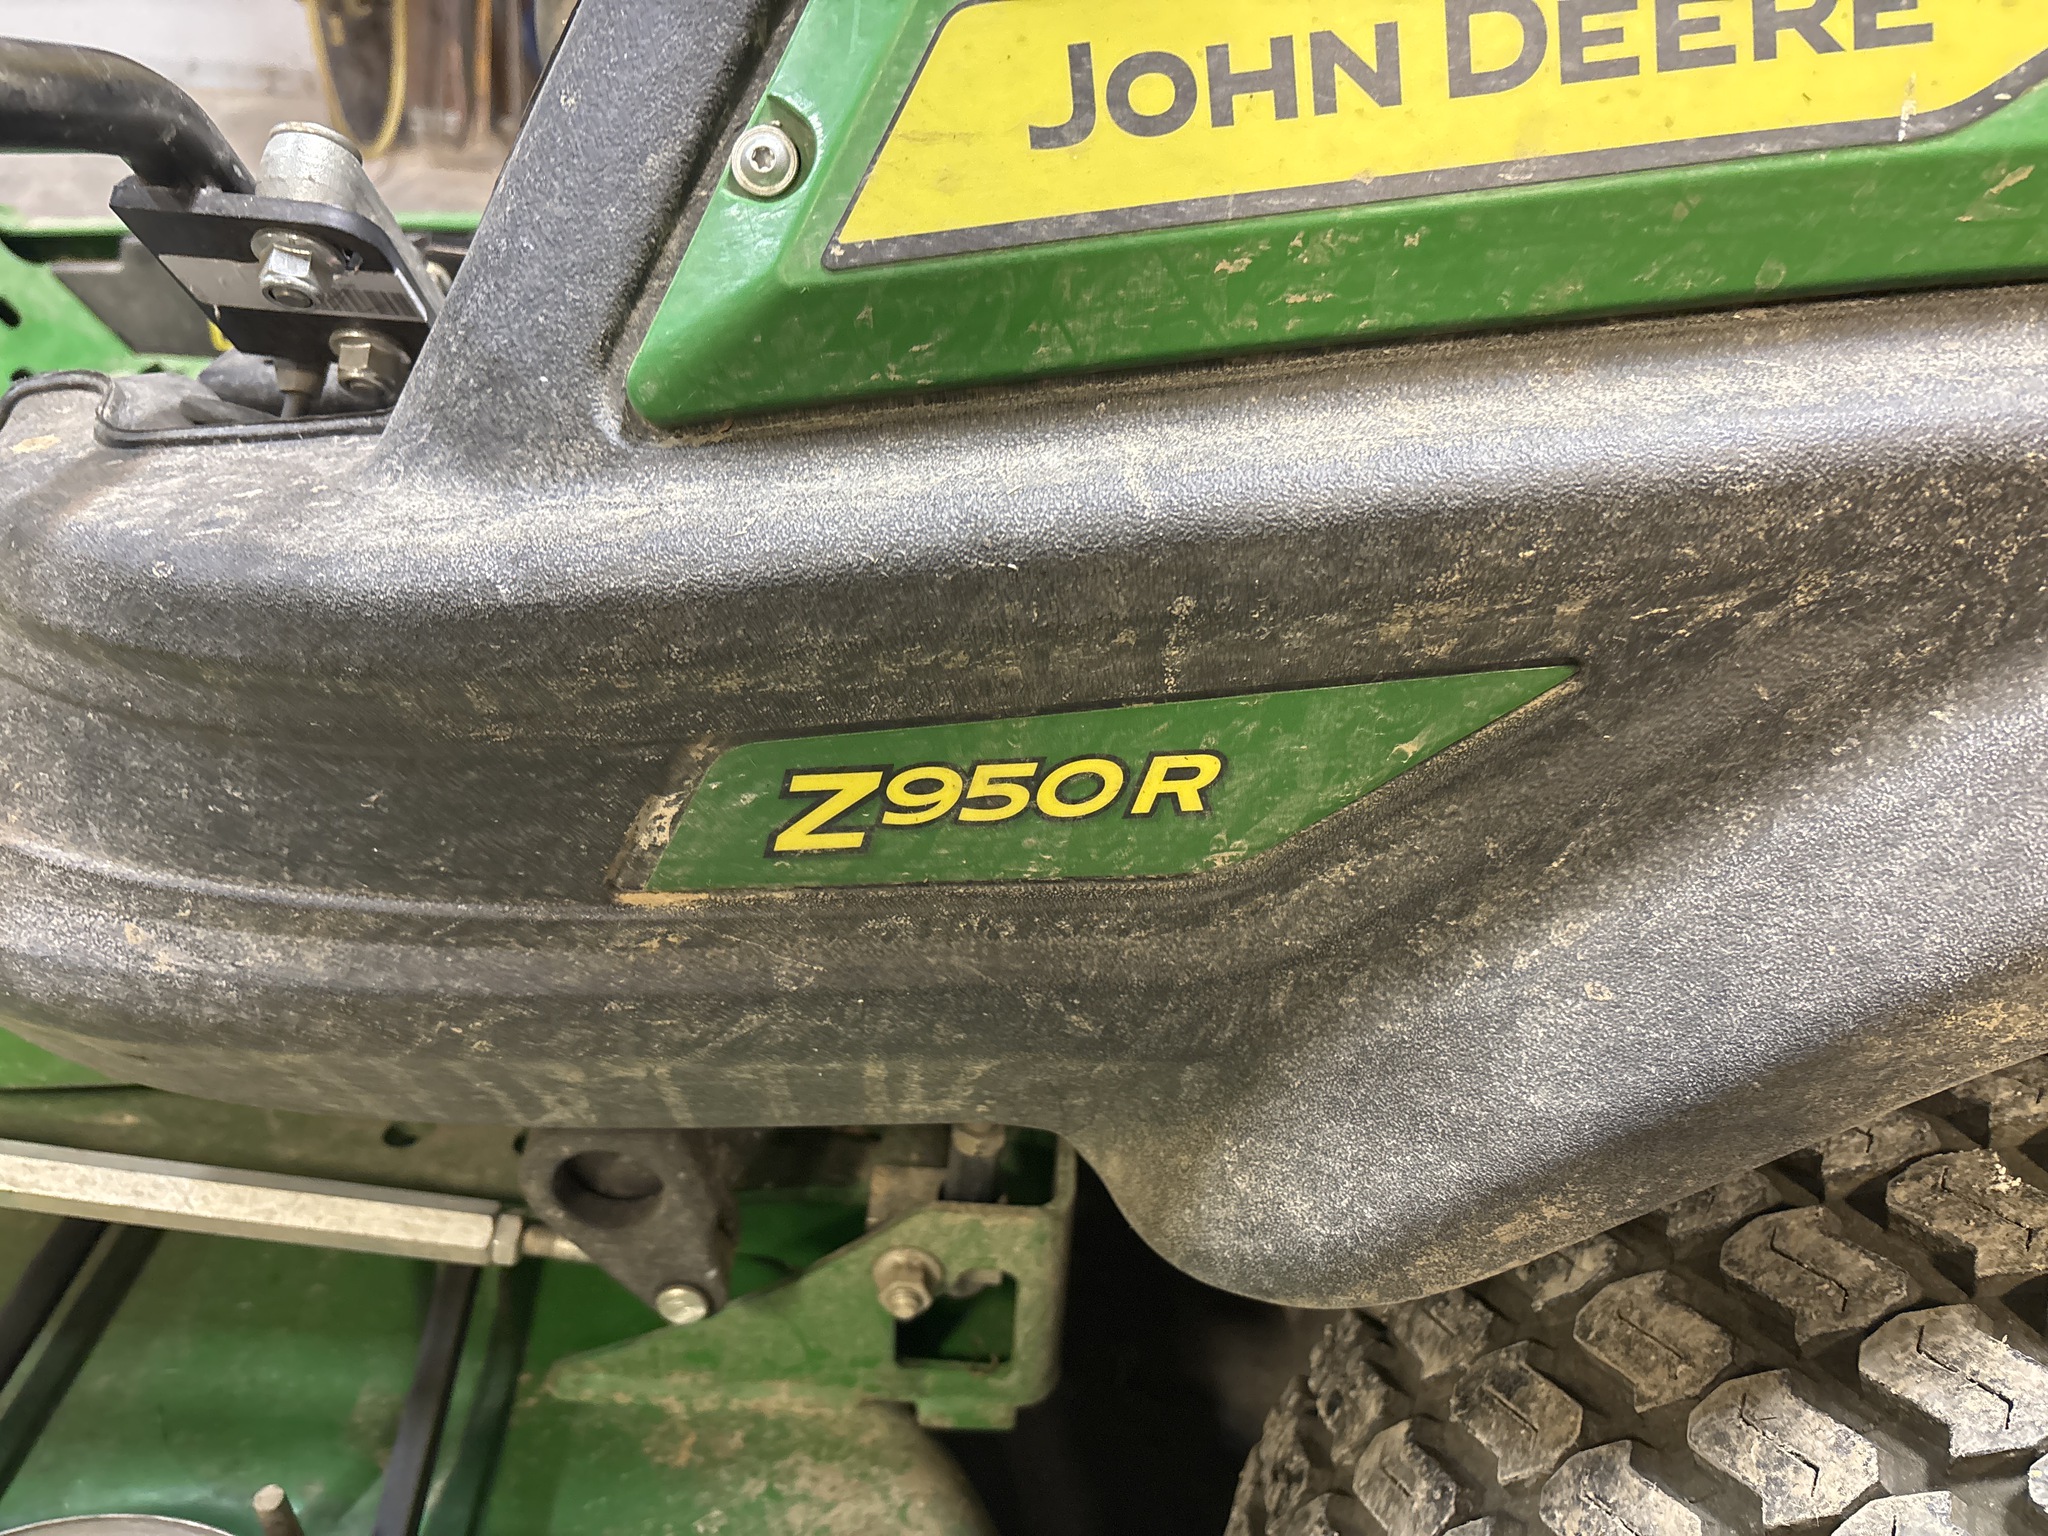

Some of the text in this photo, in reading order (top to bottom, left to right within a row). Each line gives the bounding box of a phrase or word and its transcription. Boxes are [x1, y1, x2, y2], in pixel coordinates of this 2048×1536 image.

[1028, 0, 1934, 151] JOHN DEERE
[768, 751, 1225, 855] Z950R
